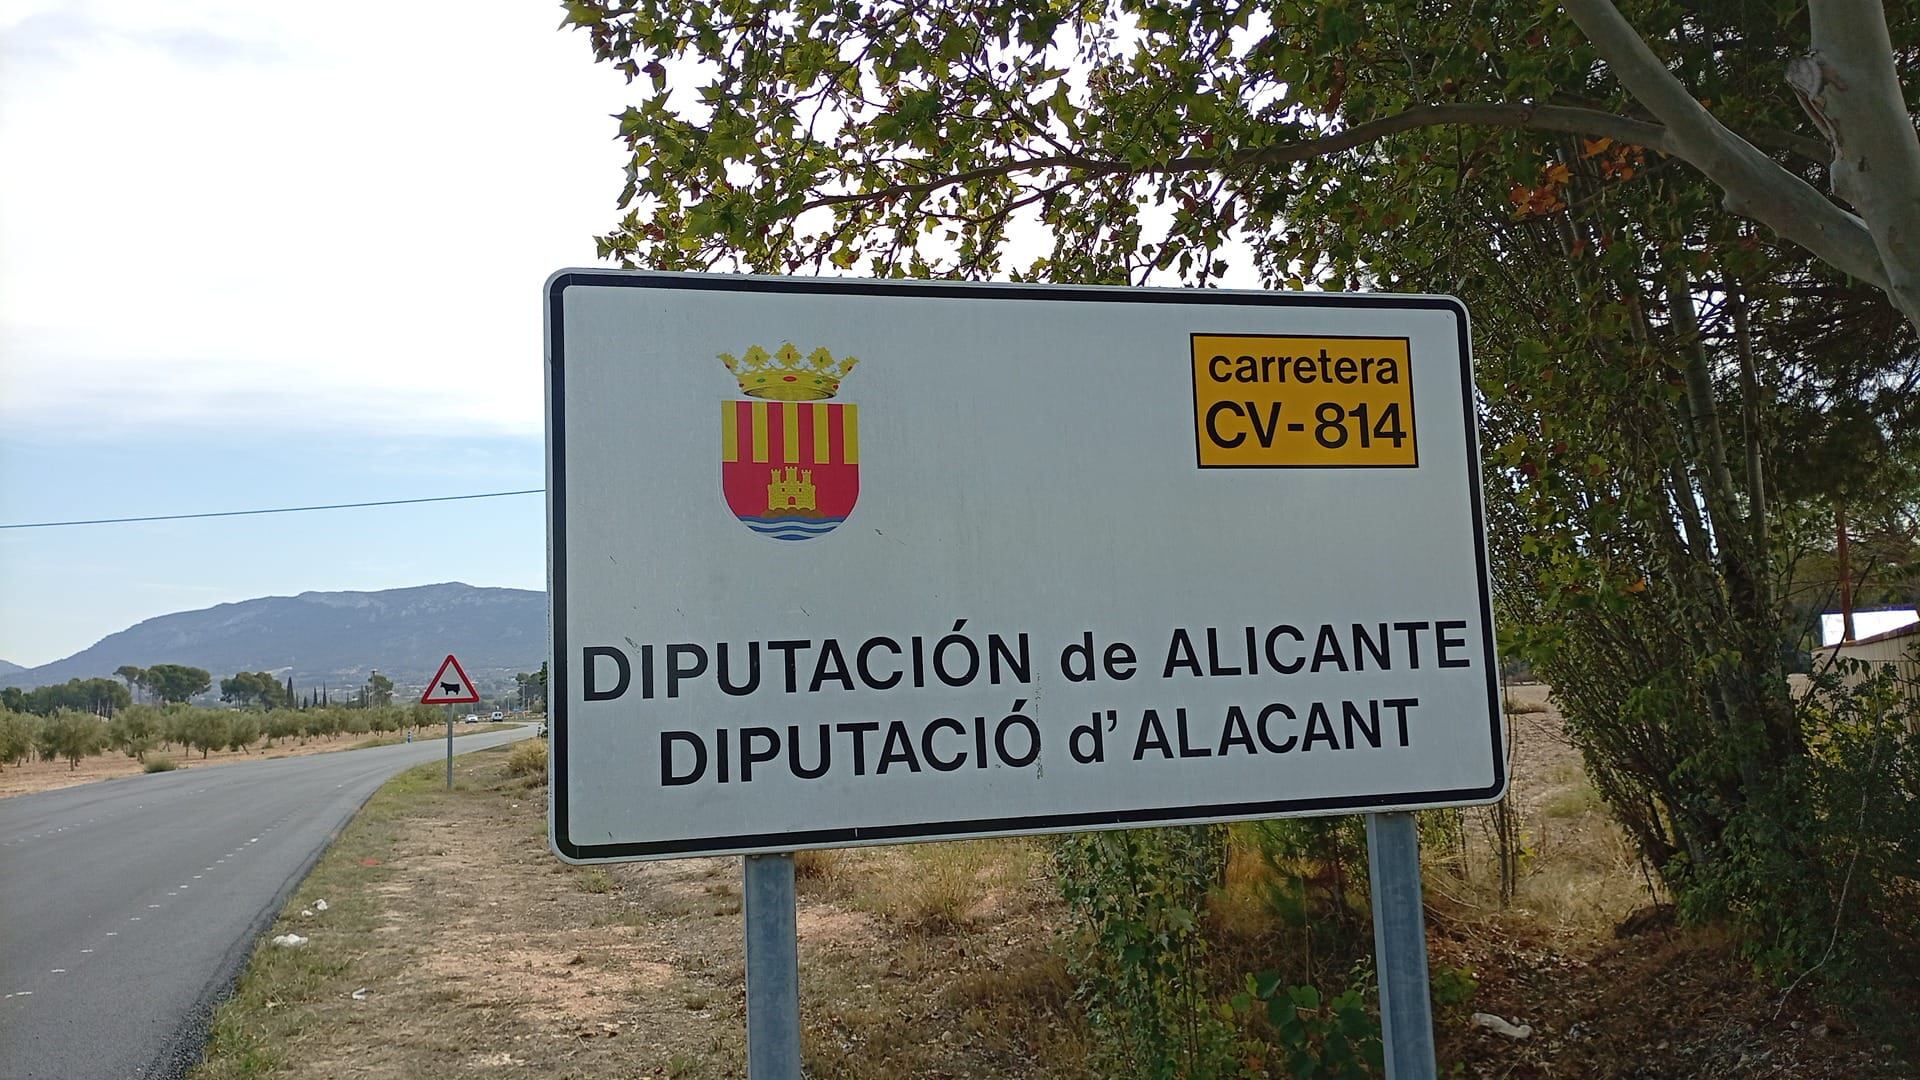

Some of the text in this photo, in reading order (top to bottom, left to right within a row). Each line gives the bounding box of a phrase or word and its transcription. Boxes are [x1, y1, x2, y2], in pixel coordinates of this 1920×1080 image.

[1208, 348, 1399, 385] carretera
[1205, 400, 1408, 450] CV-814
[582, 618, 1471, 702] DIPUTACIÓN de ALICANTE
[660, 698, 1042, 787] DIPUTACIÓ
